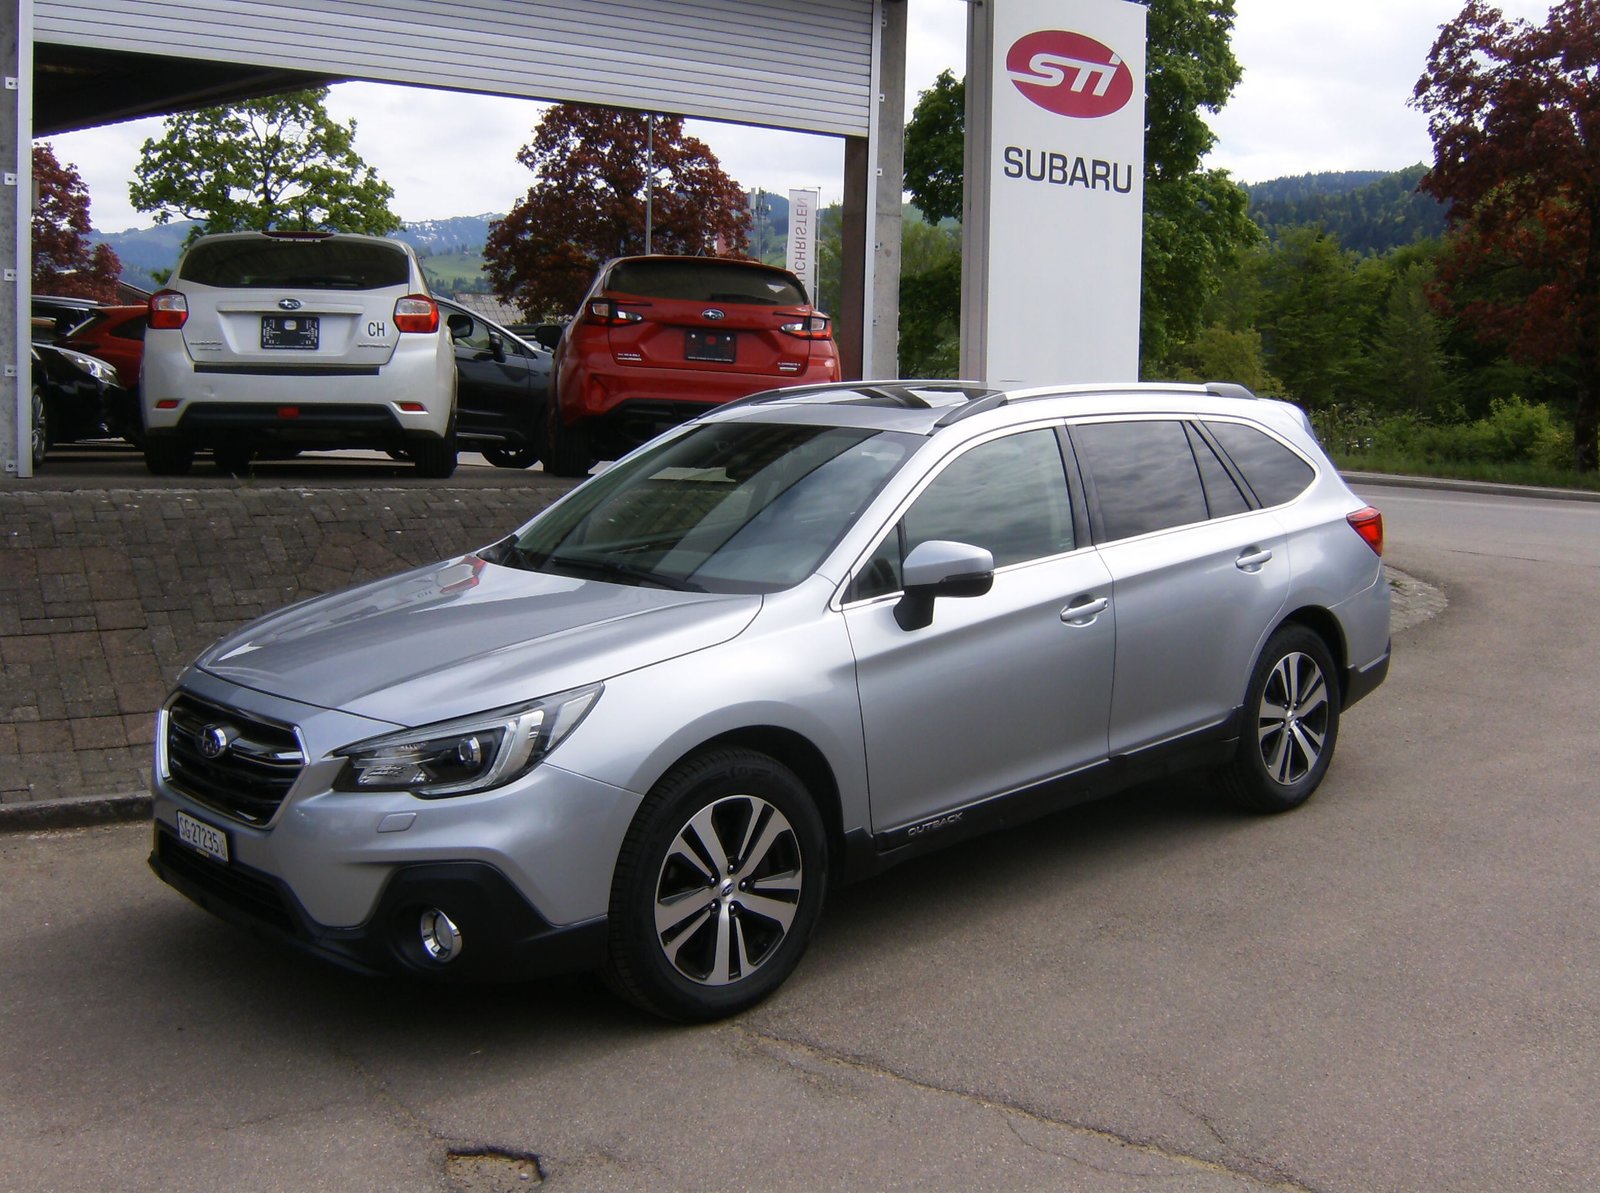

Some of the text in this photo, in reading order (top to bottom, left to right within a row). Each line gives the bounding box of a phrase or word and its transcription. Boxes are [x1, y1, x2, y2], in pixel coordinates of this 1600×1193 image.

[1003, 146, 1132, 194] SUBARU
[368, 321, 385, 337] CH
[908, 813, 962, 836] OUTBACK
